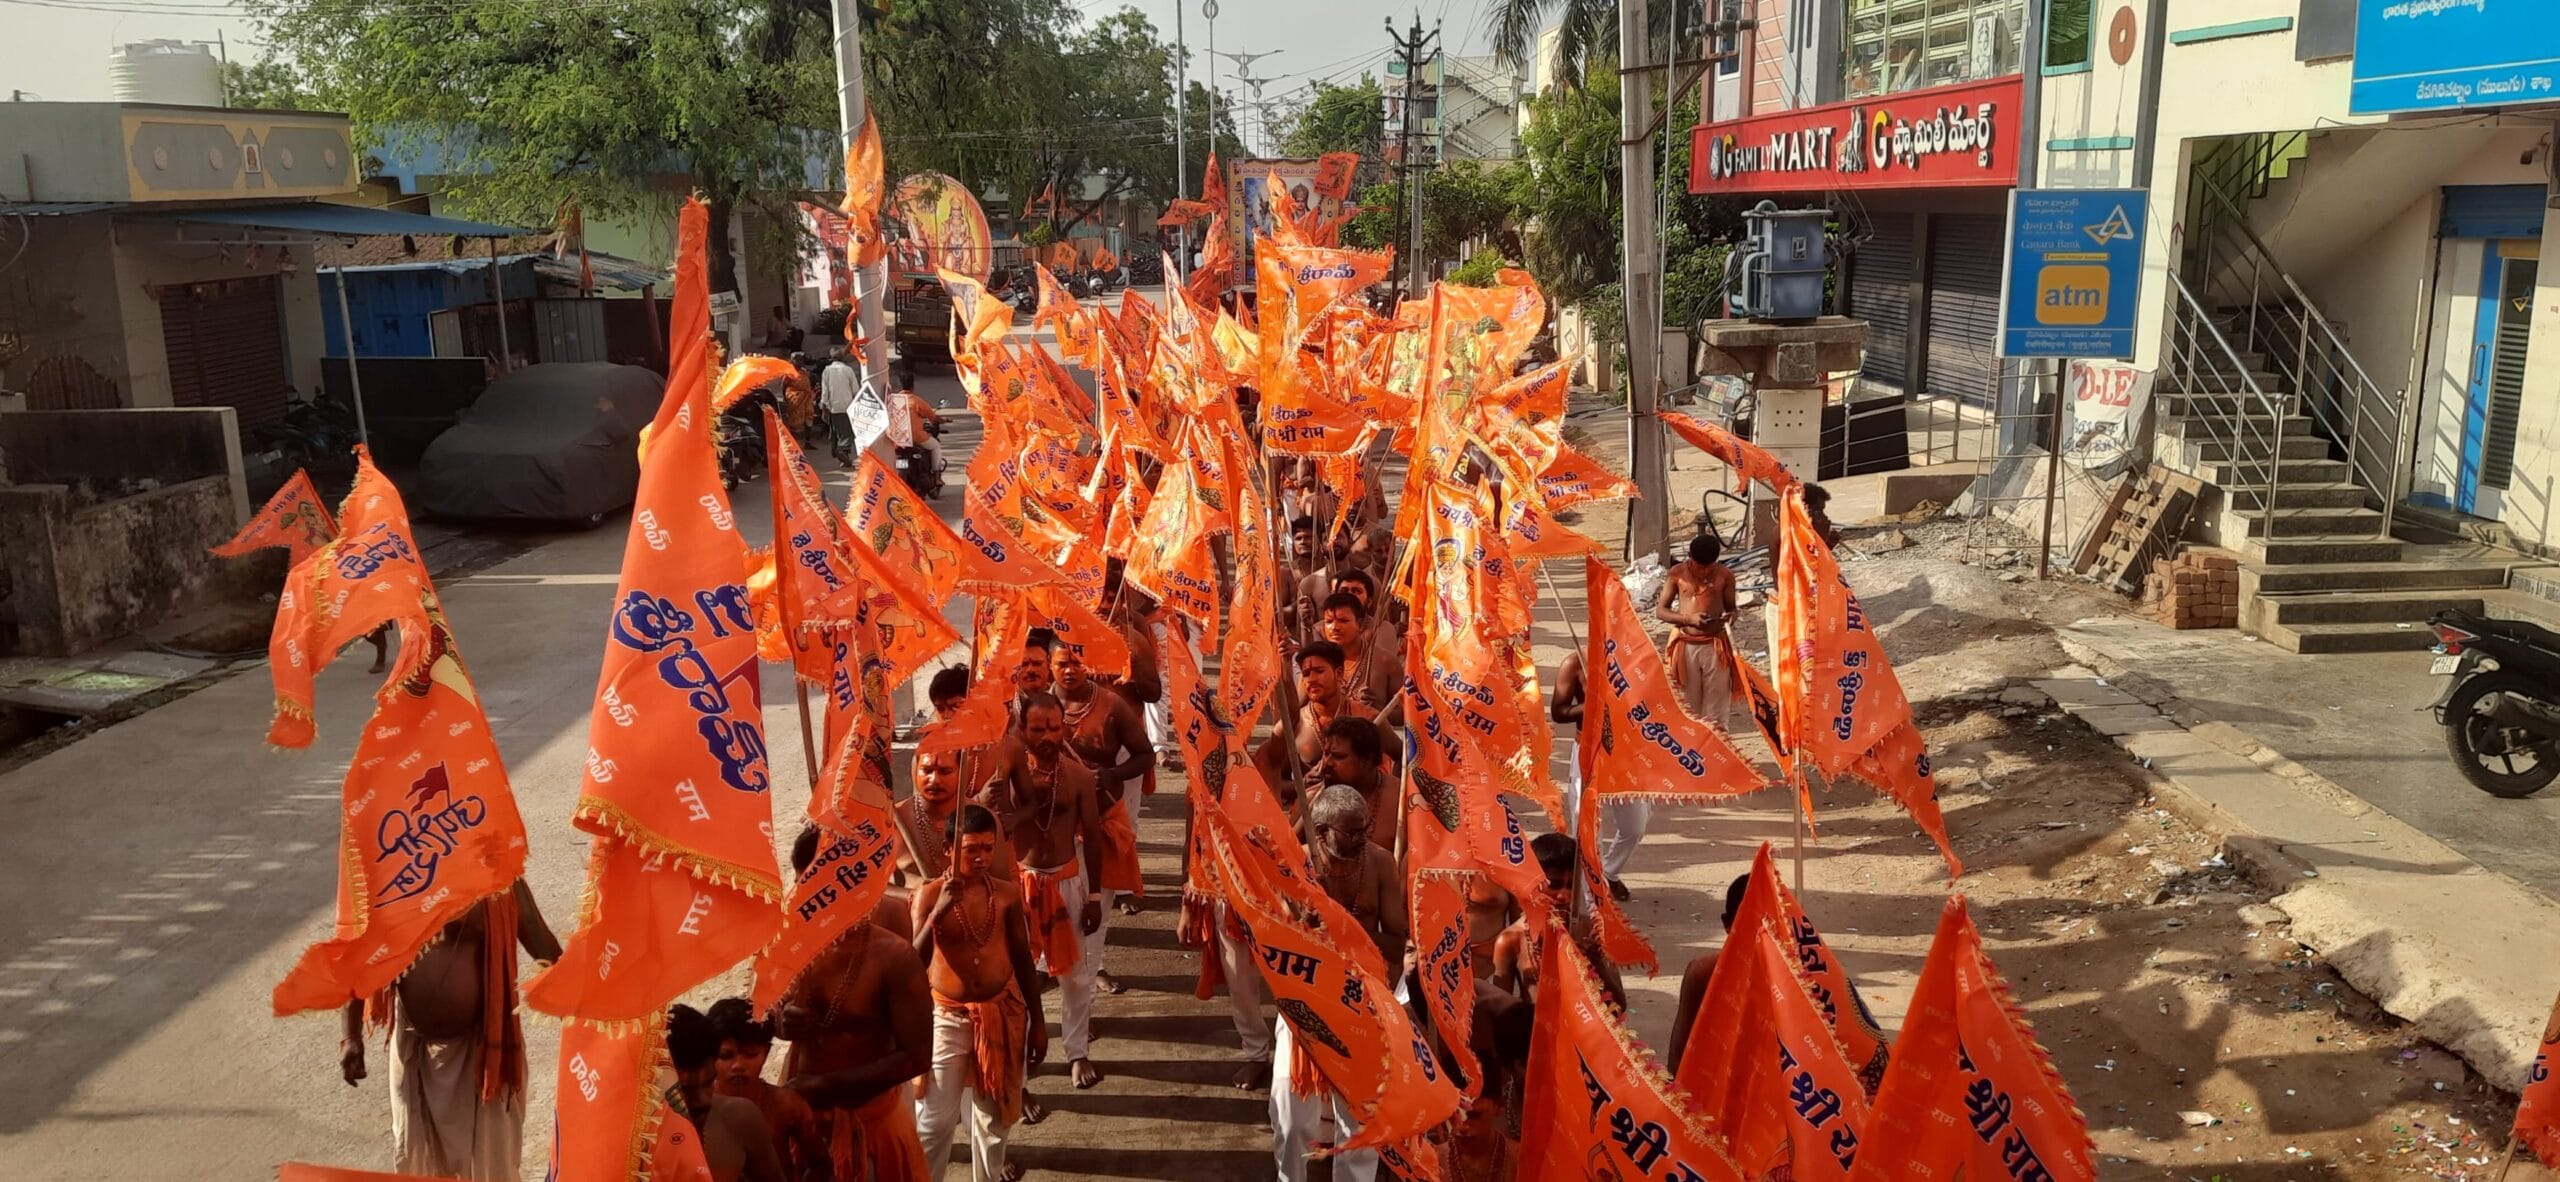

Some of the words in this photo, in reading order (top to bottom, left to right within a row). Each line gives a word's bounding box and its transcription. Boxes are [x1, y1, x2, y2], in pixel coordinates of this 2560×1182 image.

[1873, 110, 1889, 169] G
[2020, 239, 2055, 250] Canara
[2056, 239, 2081, 250] Bank
[1297, 263, 1356, 285] శ్రీరామ్
[2044, 284, 2101, 306] atm
[1278, 425, 1297, 442] श्री
[1300, 425, 1325, 440] राम
[1607, 658, 1632, 699] राम
[1464, 708, 1498, 736] राम
[1641, 721, 1706, 777] శ్రీరామ్
[1263, 943, 1323, 985] राम
[1789, 1070, 1841, 1130] श्री
[1964, 1077, 2014, 1144] श्री
[1609, 1106, 1670, 1177] श्री
